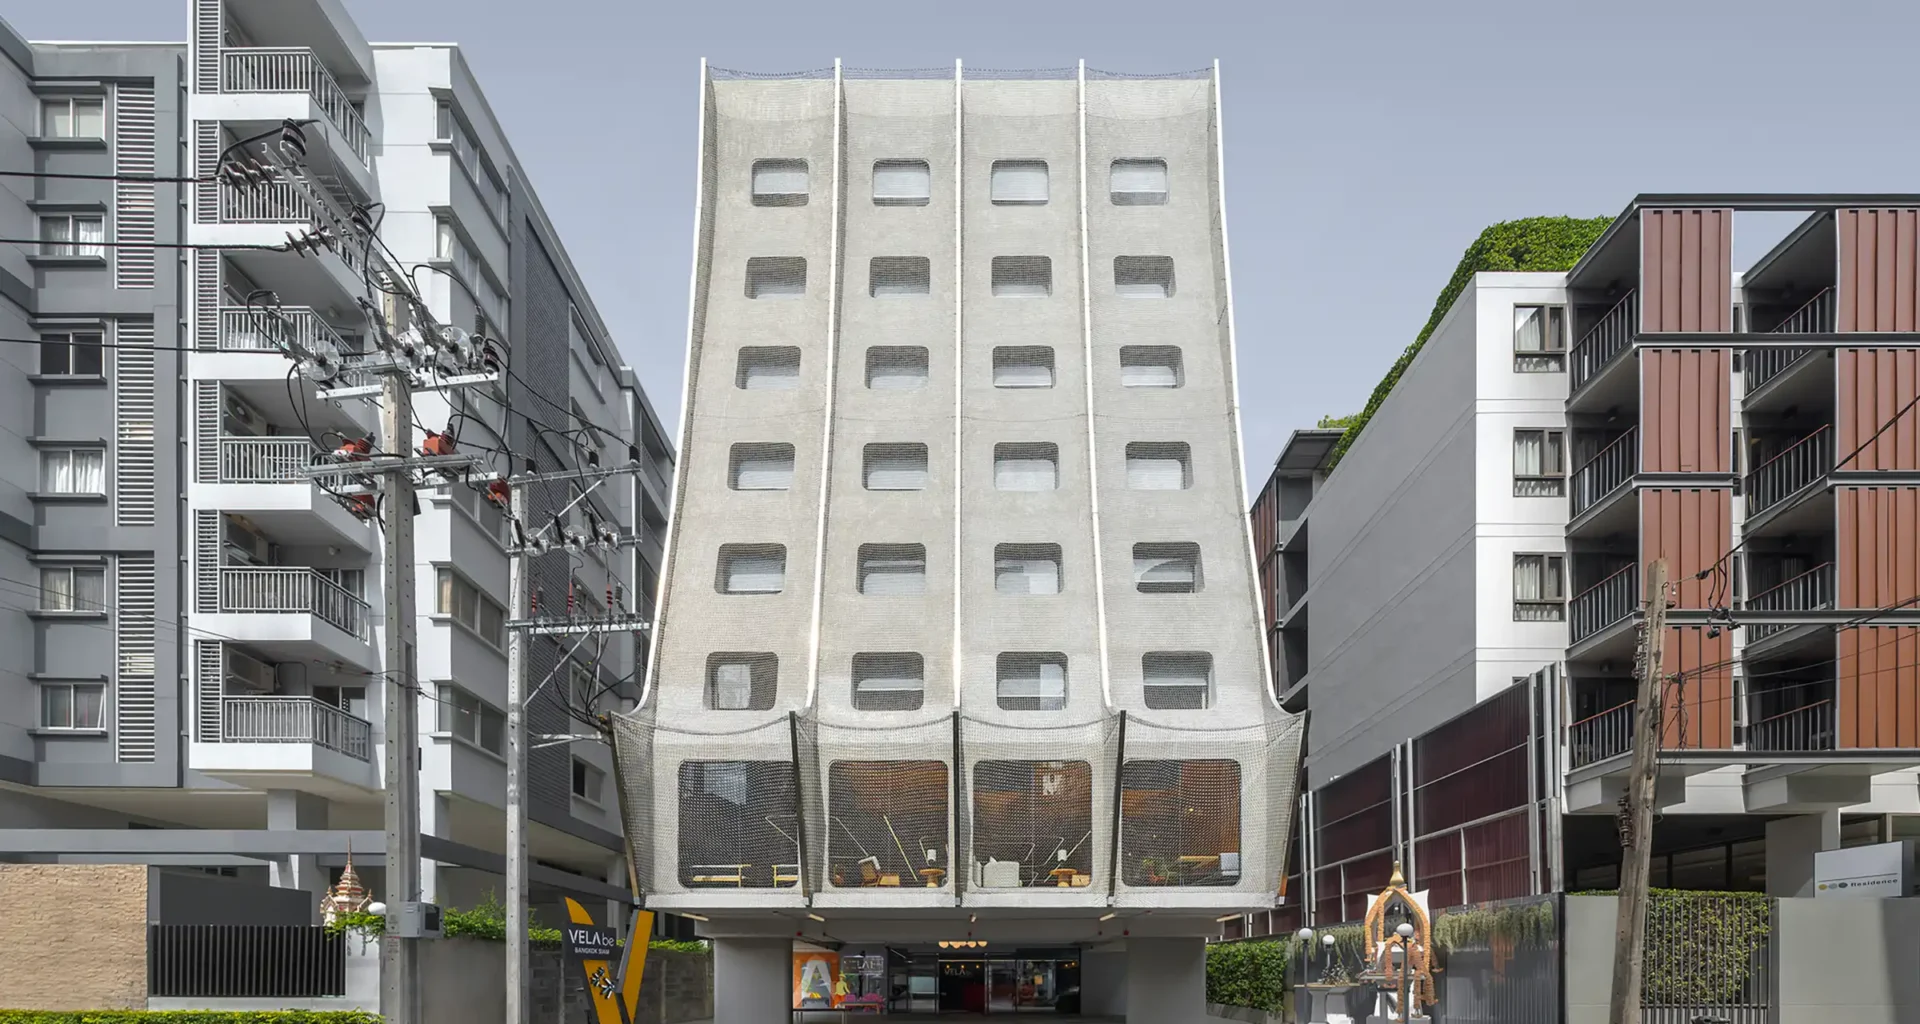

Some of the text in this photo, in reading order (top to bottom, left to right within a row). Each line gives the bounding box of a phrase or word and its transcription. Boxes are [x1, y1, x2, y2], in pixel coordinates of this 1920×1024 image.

[1850, 879, 1898, 887] Residence
[568, 928, 615, 947] VELA be
[574, 946, 598, 954] BANGKOK
